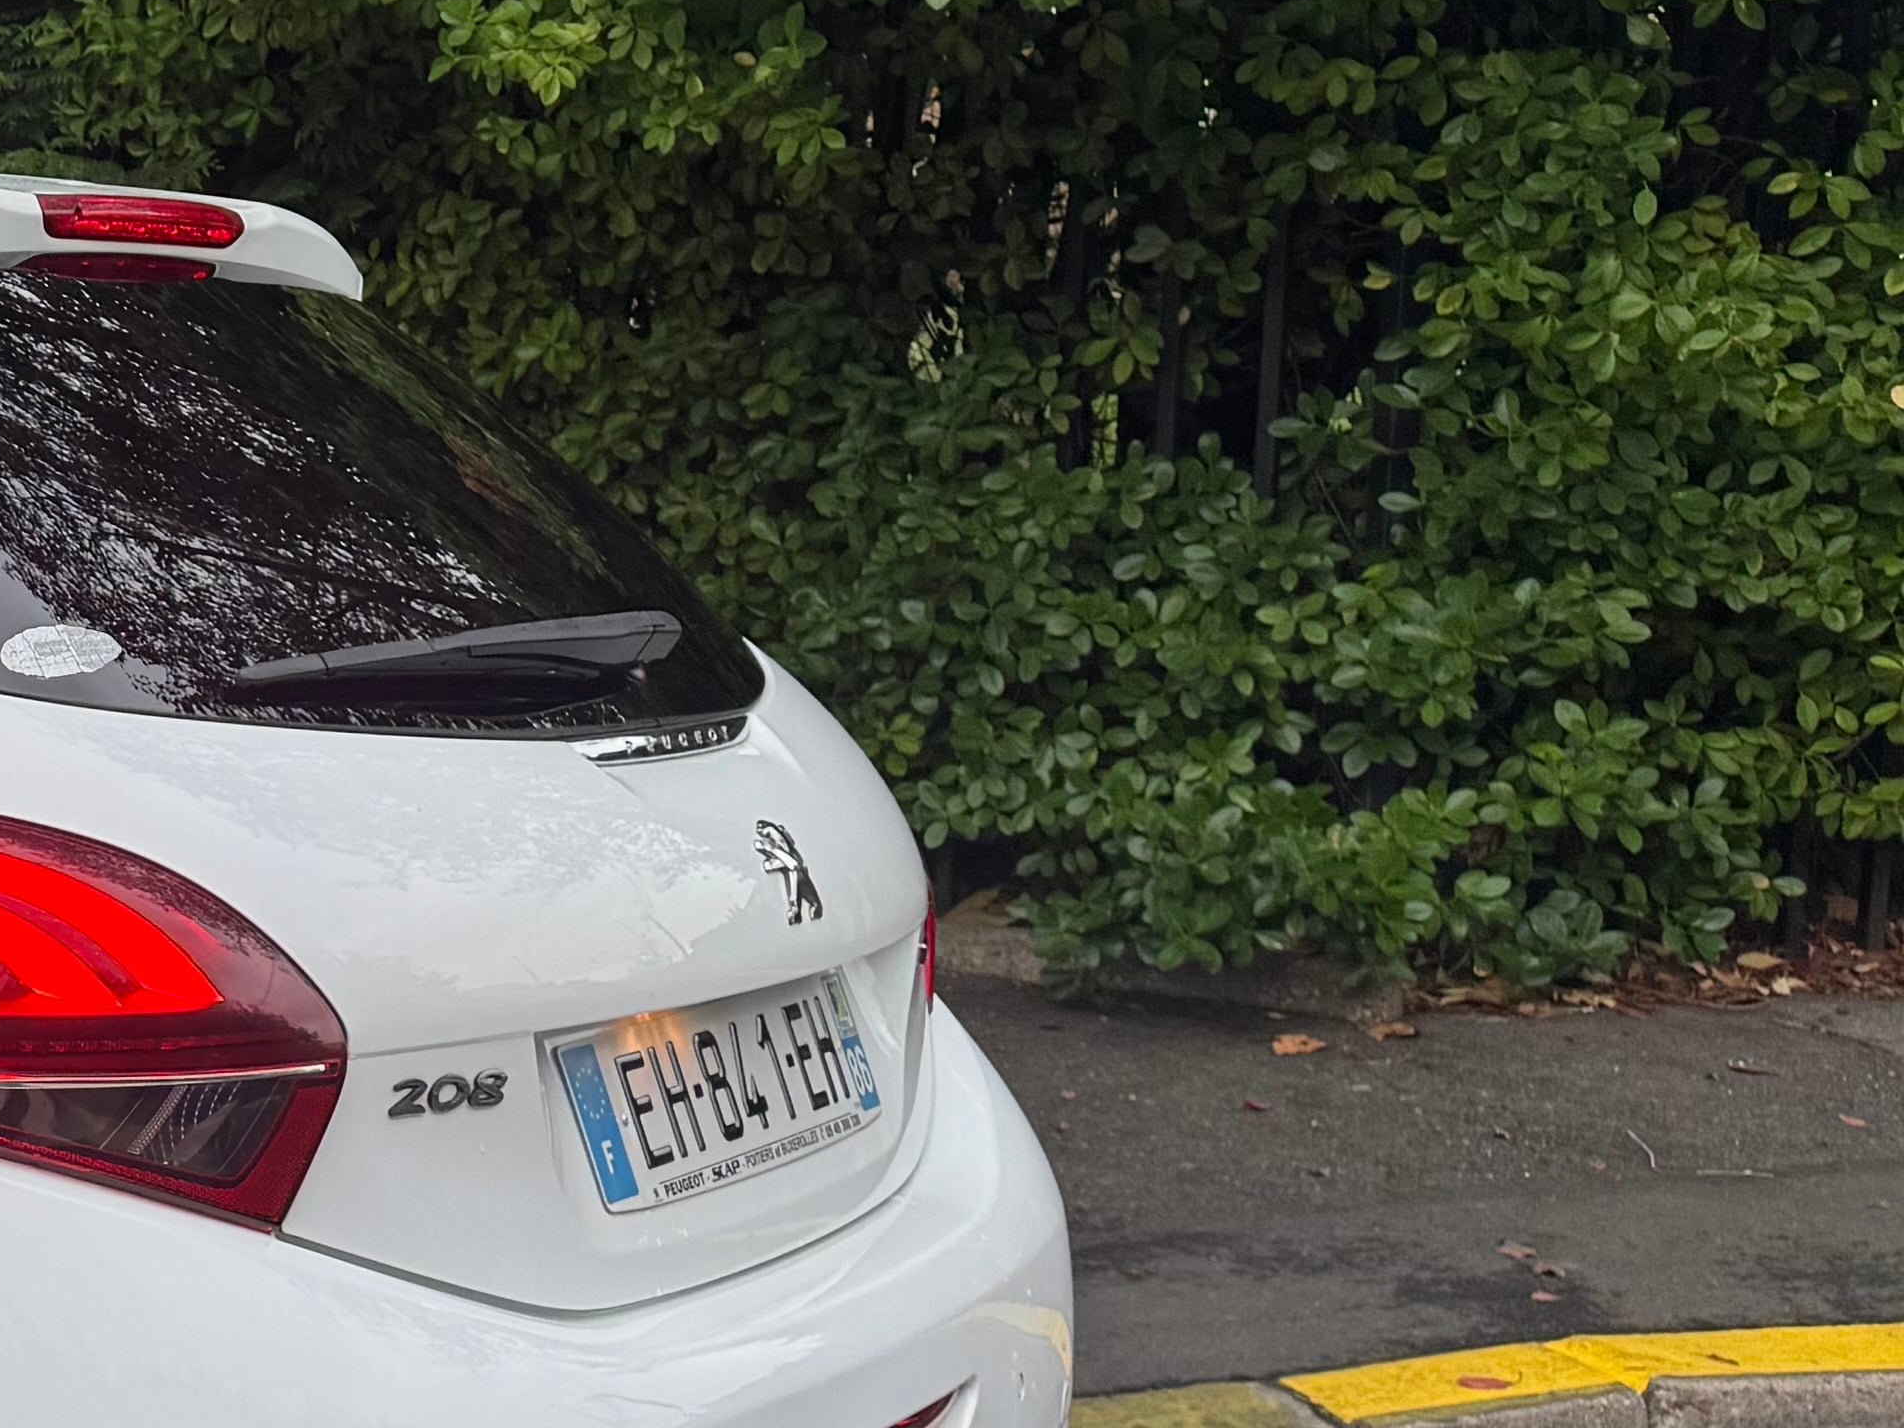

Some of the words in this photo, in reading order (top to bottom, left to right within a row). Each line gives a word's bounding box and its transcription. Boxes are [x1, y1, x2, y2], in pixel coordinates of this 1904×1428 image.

[625, 725, 730, 755] PEUGEOT
[614, 995, 852, 1170] EH-841-EH
[846, 1045, 875, 1097] 86
[388, 1068, 508, 1120] 208
[600, 1139, 616, 1175] F
[663, 1171, 706, 1198] PEUGEOT
[711, 1159, 742, 1183] SCAP
